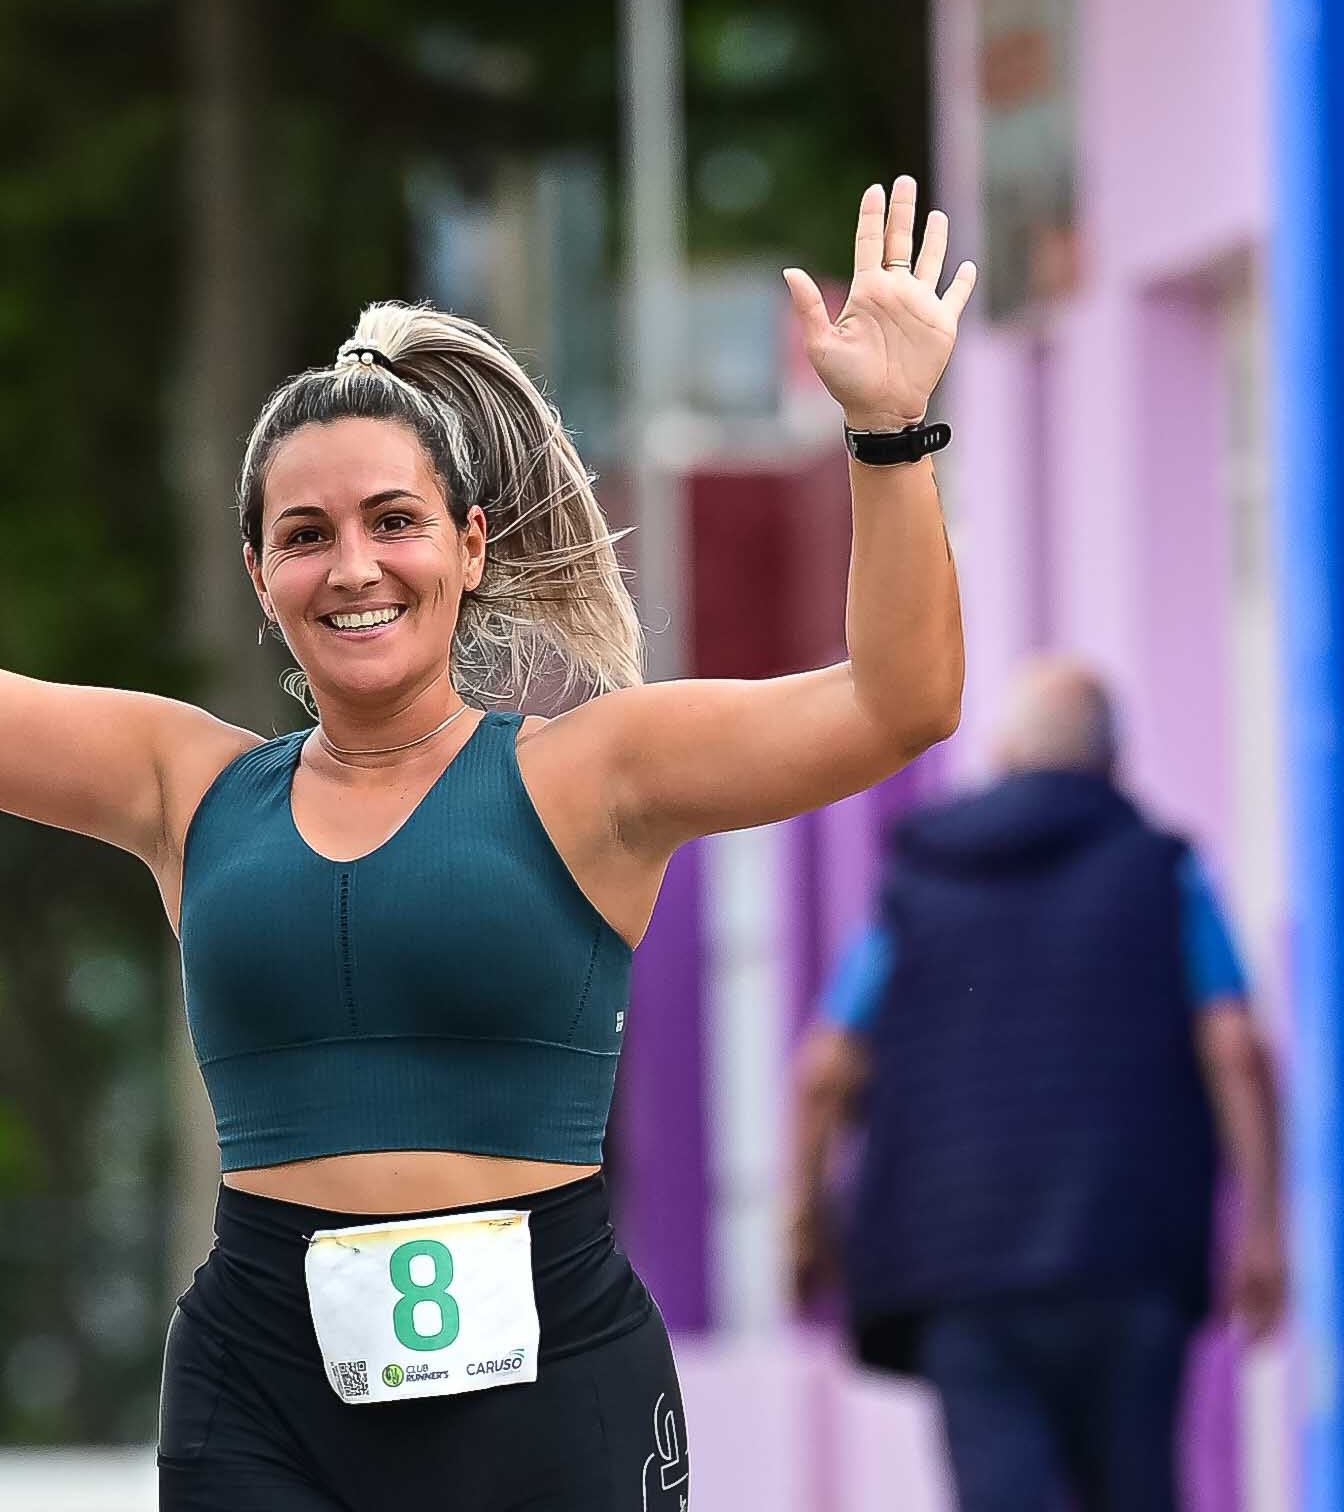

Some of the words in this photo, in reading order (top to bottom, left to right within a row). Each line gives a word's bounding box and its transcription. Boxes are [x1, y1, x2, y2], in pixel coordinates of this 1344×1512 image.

[389, 1240, 460, 1352] 8
[406, 1364, 429, 1374] CLUB
[466, 1357, 523, 1376] CARUSO
